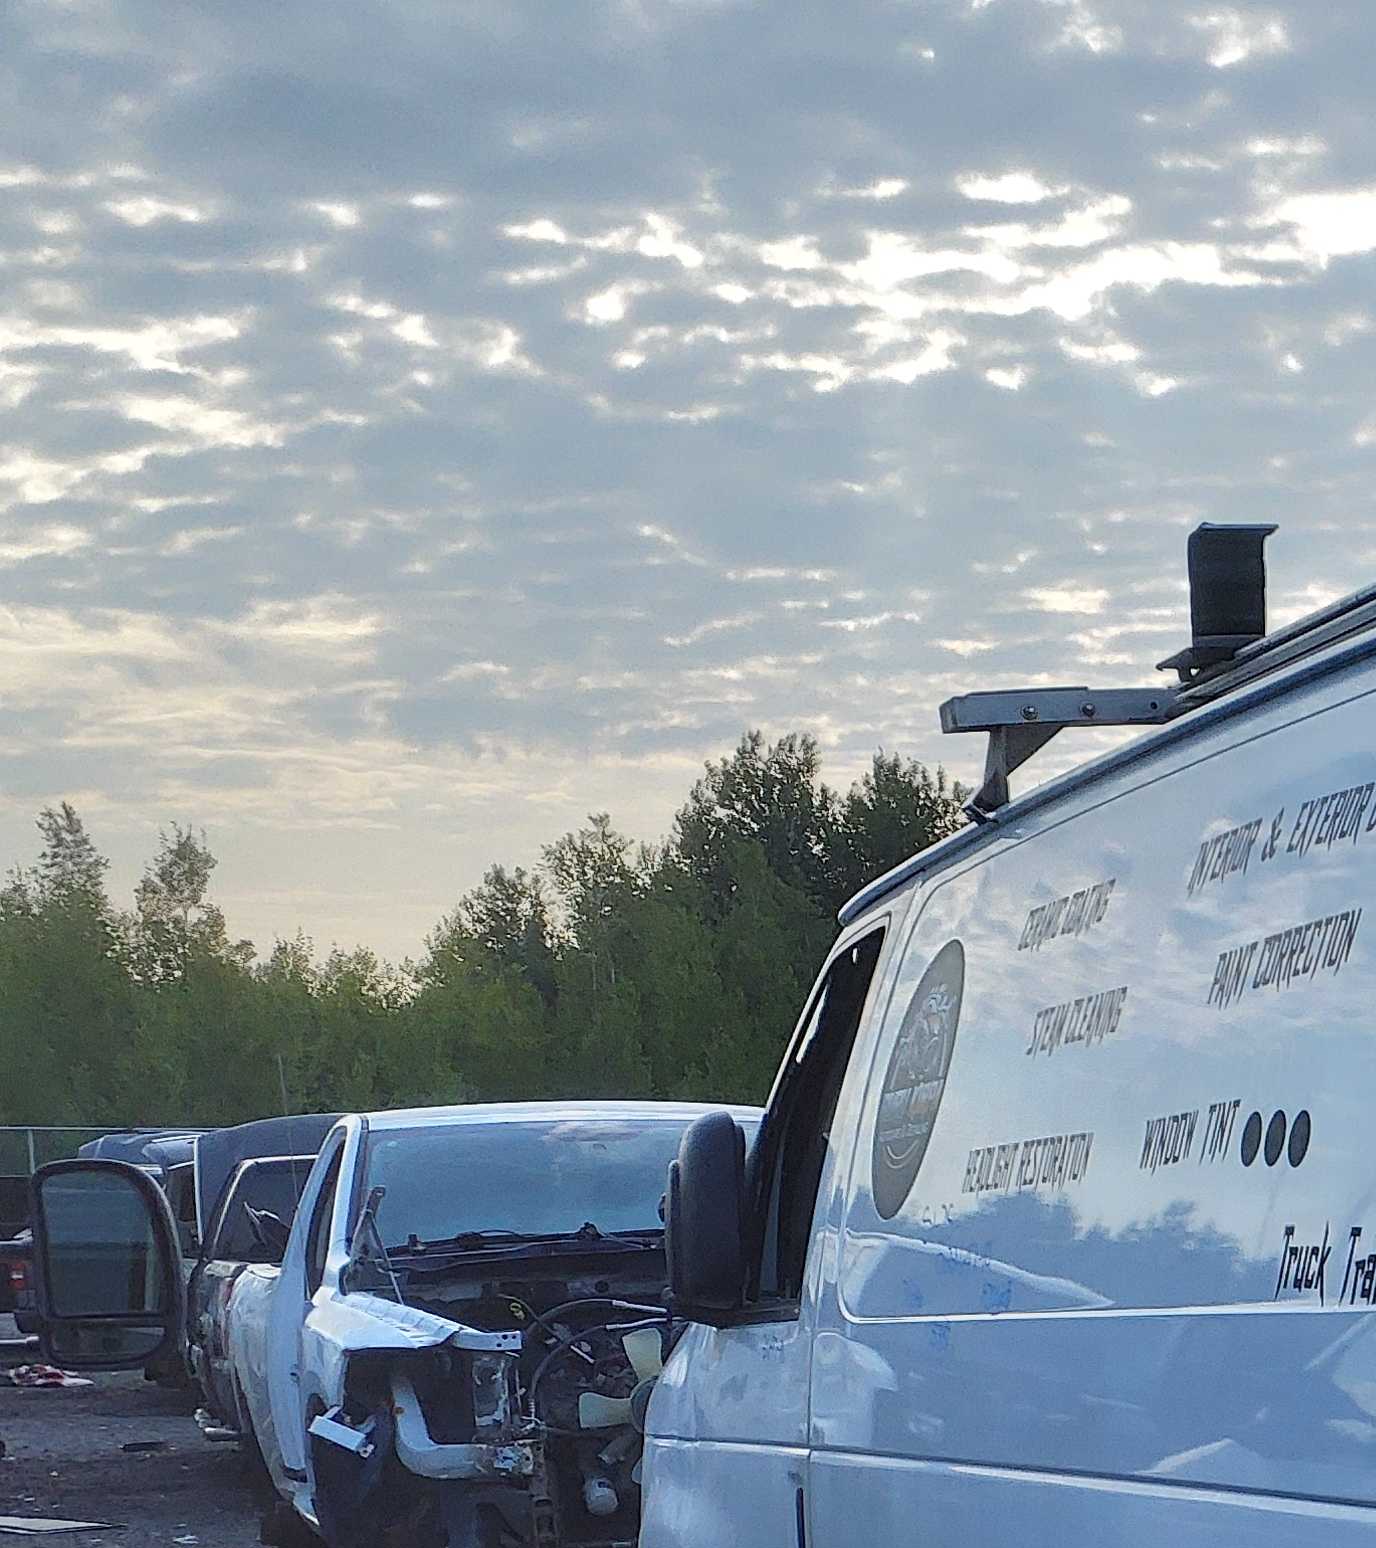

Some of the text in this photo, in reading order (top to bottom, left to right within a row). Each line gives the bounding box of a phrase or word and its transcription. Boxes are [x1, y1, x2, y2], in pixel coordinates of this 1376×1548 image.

[1187, 818, 1263, 899] INTERIOR
[1261, 807, 1285, 863] &
[1286, 782, 1376, 859] EXTERIOR
[1207, 907, 1362, 1010] PAINT CORRECTION
[1139, 1099, 1242, 1176] WINDOW TINT
[1274, 1220, 1332, 1307] Truck
